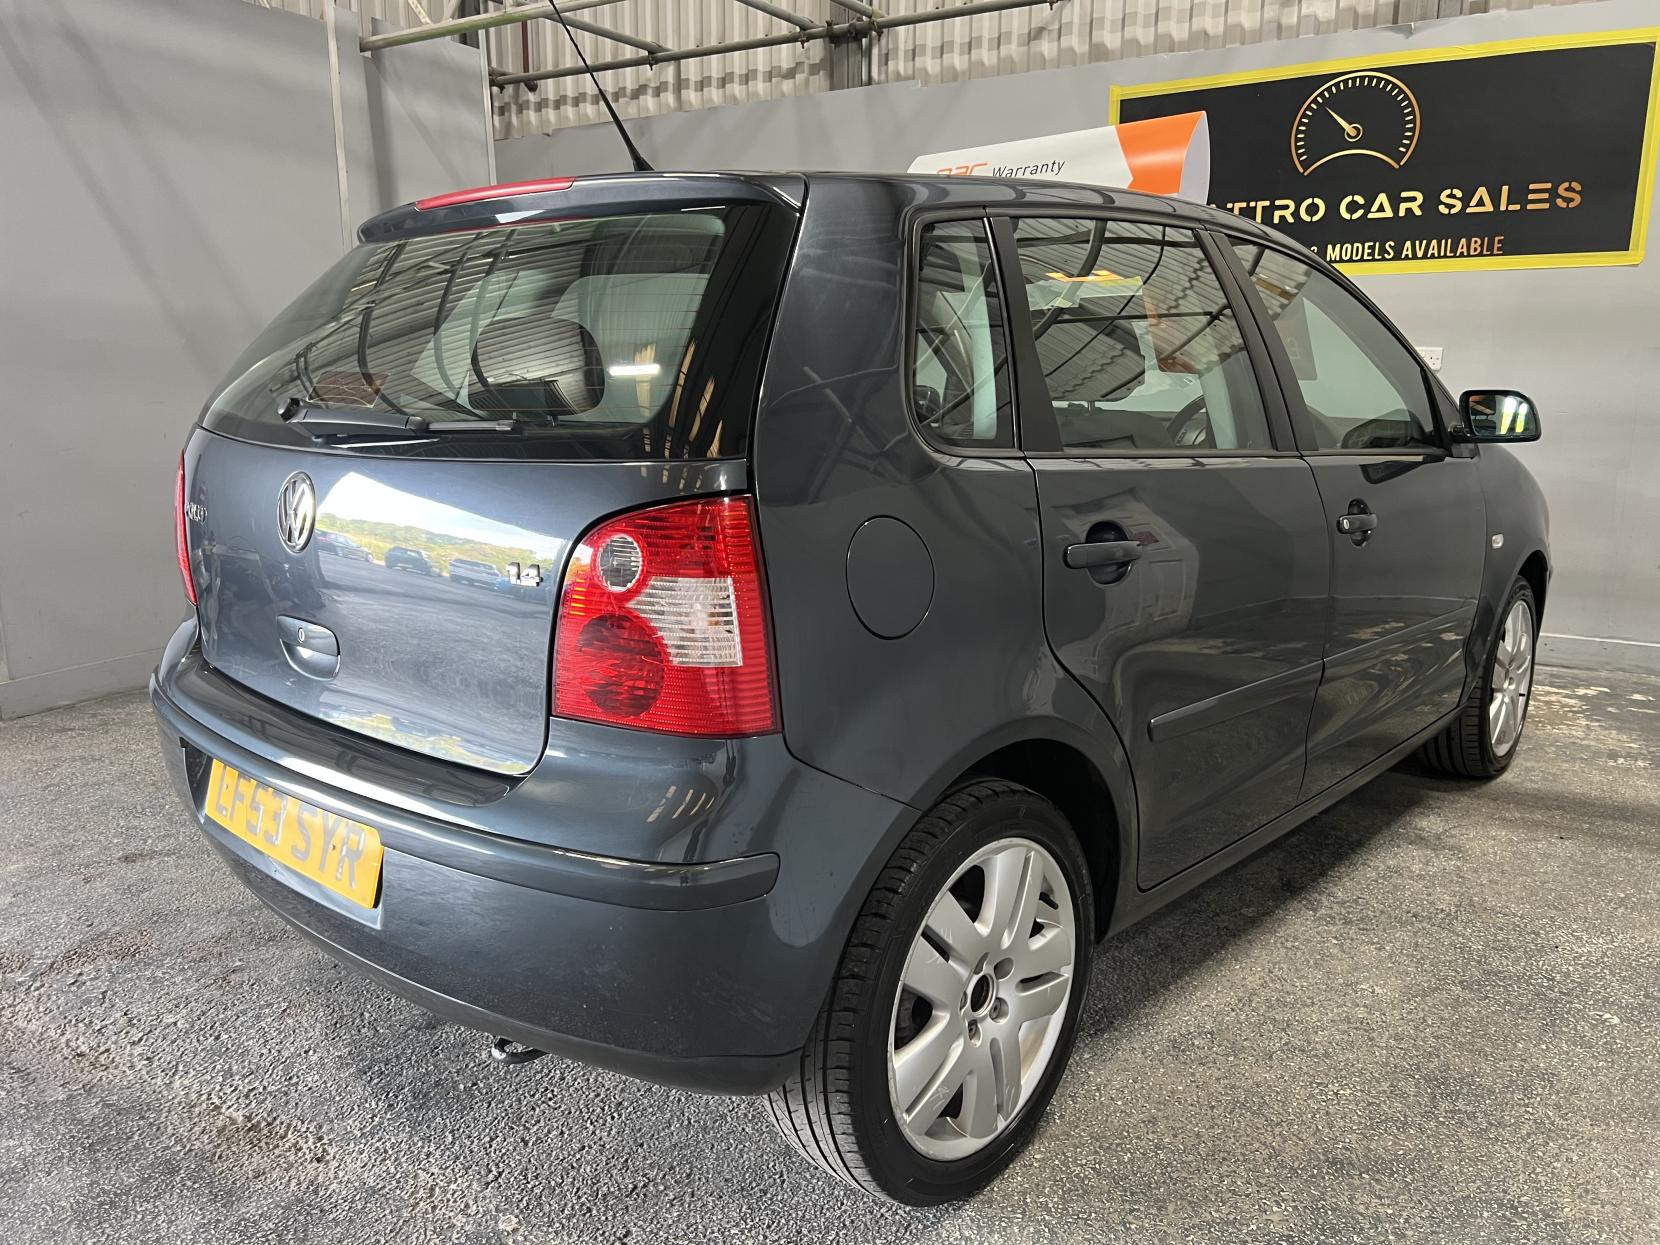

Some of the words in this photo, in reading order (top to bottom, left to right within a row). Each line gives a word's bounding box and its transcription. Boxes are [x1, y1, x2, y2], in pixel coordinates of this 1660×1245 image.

[992, 159, 1066, 178] Warranty
[1339, 190, 1424, 220] CAR
[1438, 181, 1583, 215] SALES
[1326, 241, 1395, 261] MODELS
[1401, 236, 1505, 259] AVAILABLE
[292, 806, 365, 890] SYR
